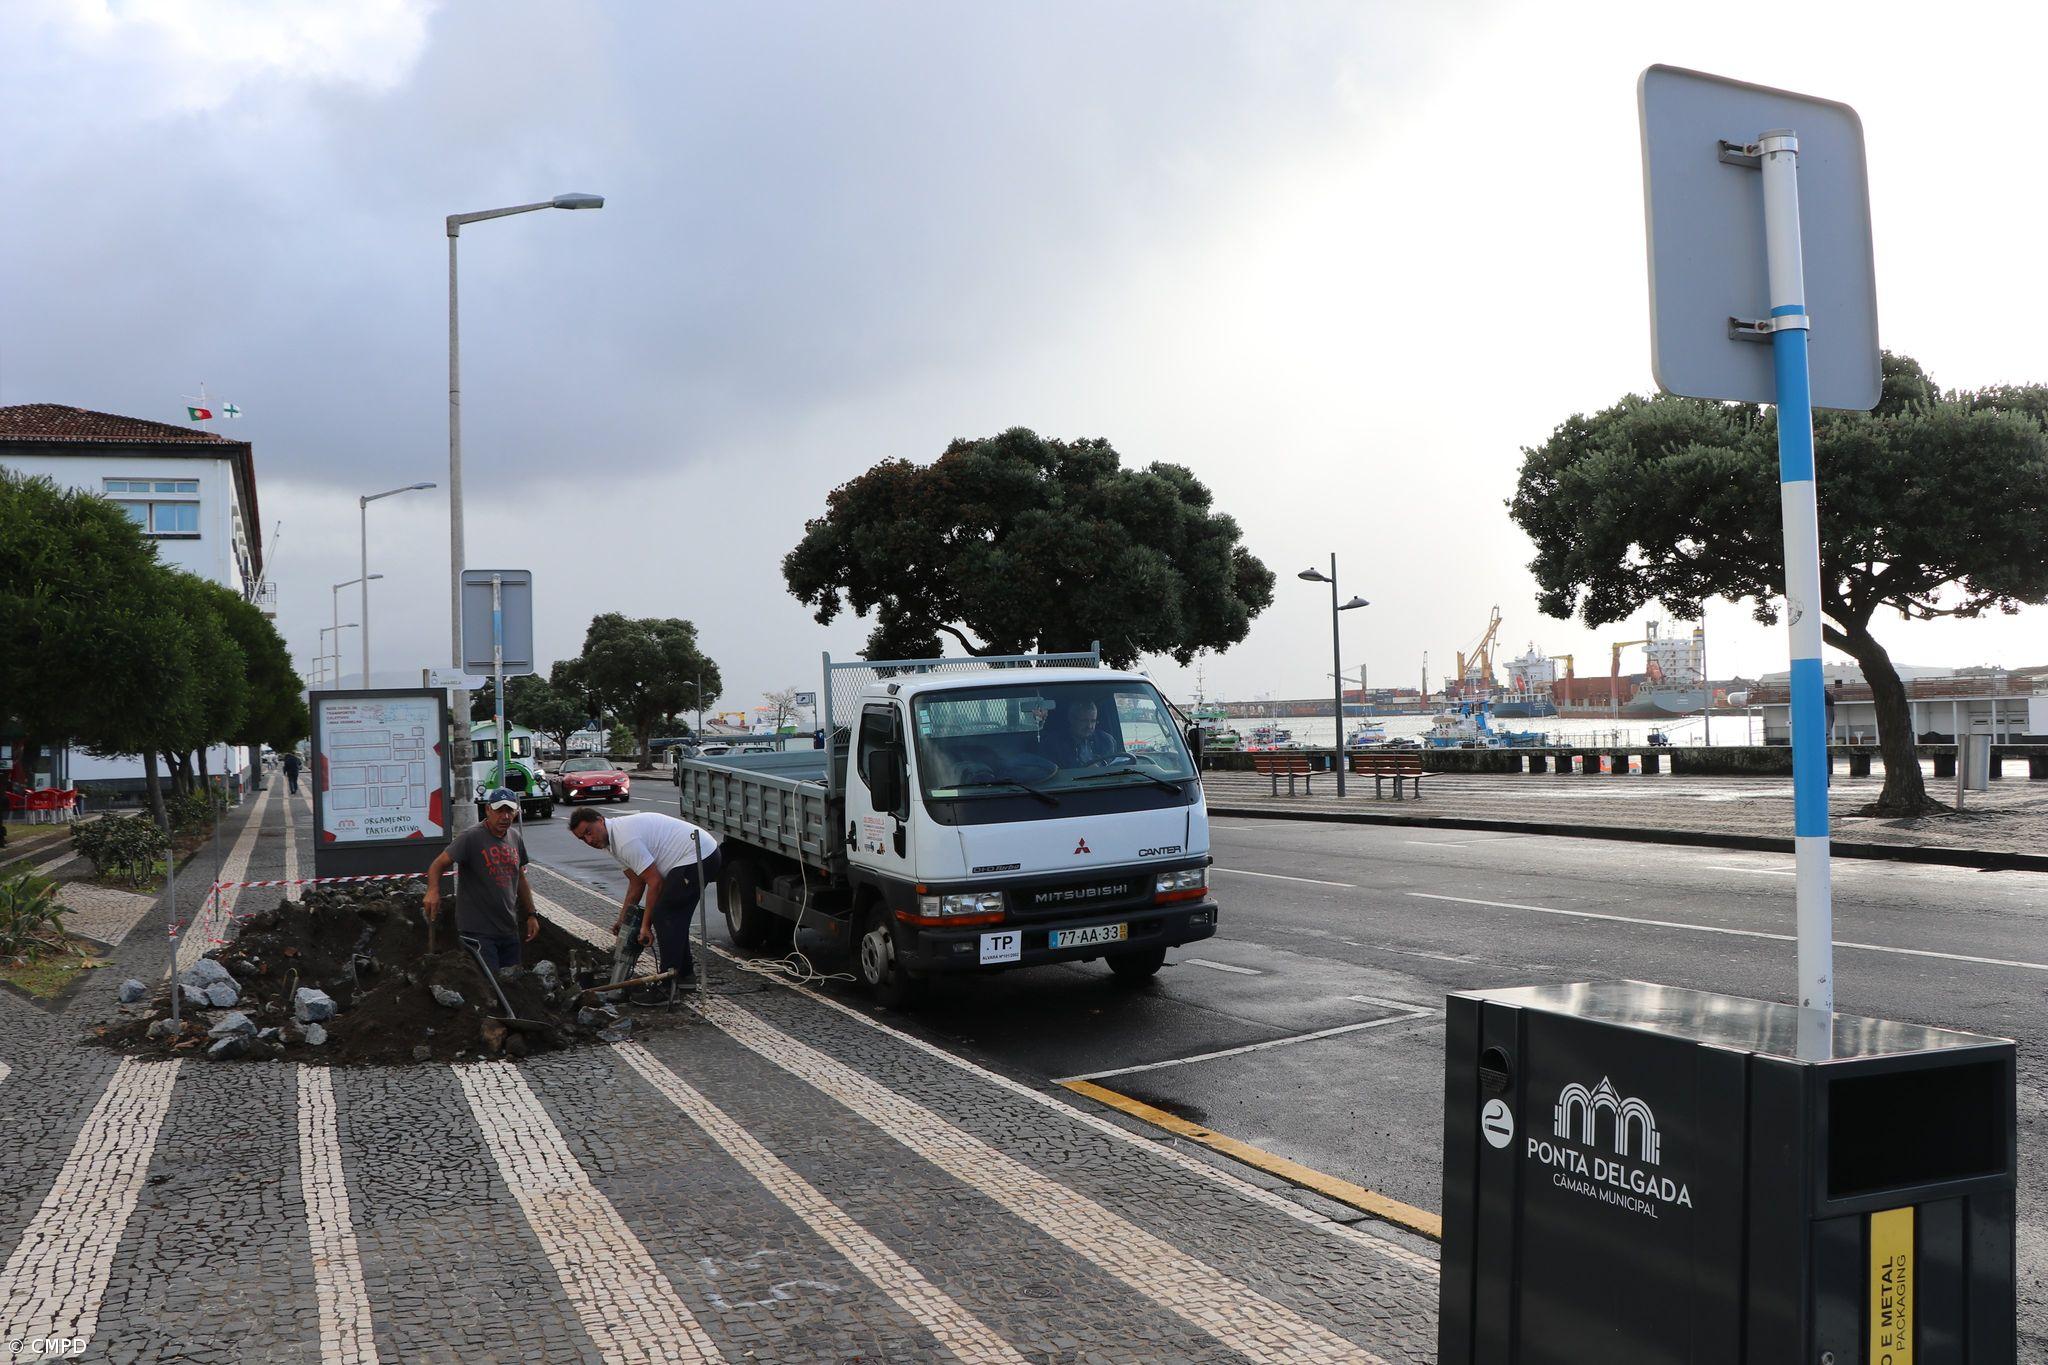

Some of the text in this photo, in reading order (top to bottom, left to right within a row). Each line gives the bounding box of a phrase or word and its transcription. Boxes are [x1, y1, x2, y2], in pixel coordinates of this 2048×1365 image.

[365, 825, 420, 835] PARTICIPATIVO
[1138, 846, 1181, 857] CANTER
[1035, 884, 1129, 903] MITSUBISHI
[1059, 926, 1119, 946] 77-AA-33
[1527, 1137, 1693, 1209] PONTA DELGADA
[1552, 1173, 1659, 1219] CÂMARA MUNICIPAL
[1881, 1255, 1893, 1328] METAL
[1896, 1254, 1906, 1351] PACKAGING
[1881, 1333, 1893, 1348] E
